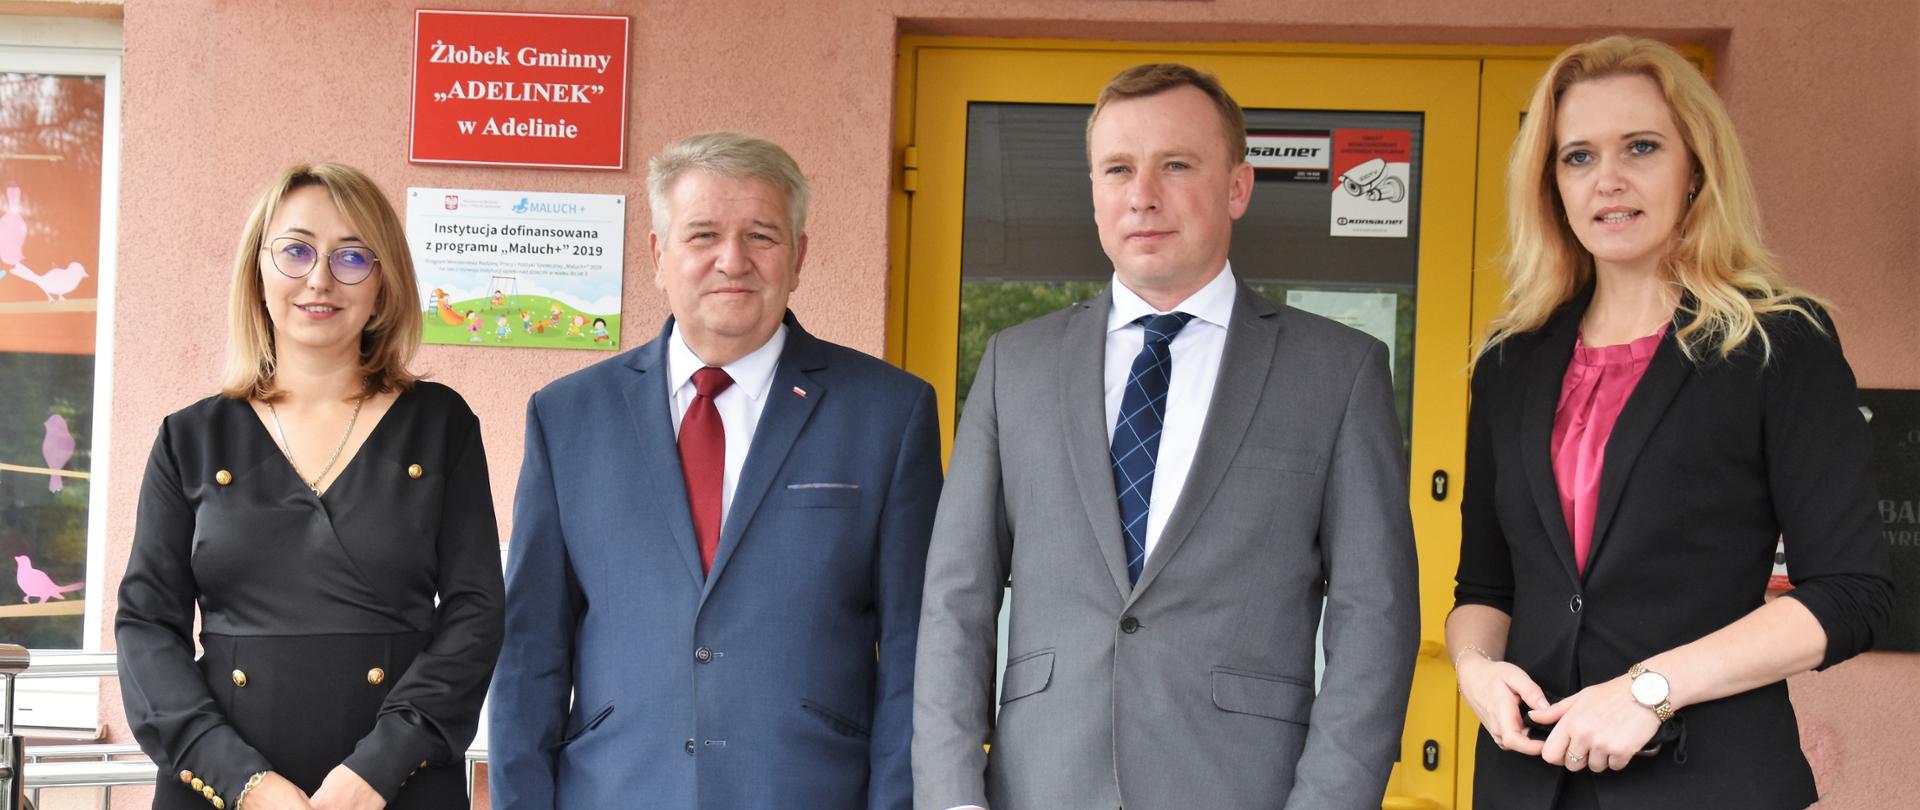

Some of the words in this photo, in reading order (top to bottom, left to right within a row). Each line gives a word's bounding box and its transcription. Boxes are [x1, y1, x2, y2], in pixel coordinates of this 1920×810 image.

[429, 40, 511, 65] Żłobek
[517, 47, 612, 73] Gminny
[433, 80, 605, 104] „ADELINEK”
[457, 120, 478, 135] w
[482, 117, 578, 138] Adelinie
[530, 202, 577, 214] MALUCH
[434, 223, 498, 237] Instytucja
[501, 225, 598, 239] dofinansowana
[425, 242, 432, 250] z
[435, 242, 498, 254] programu
[573, 245, 603, 256] 2019
[1877, 499, 1920, 524] BA
